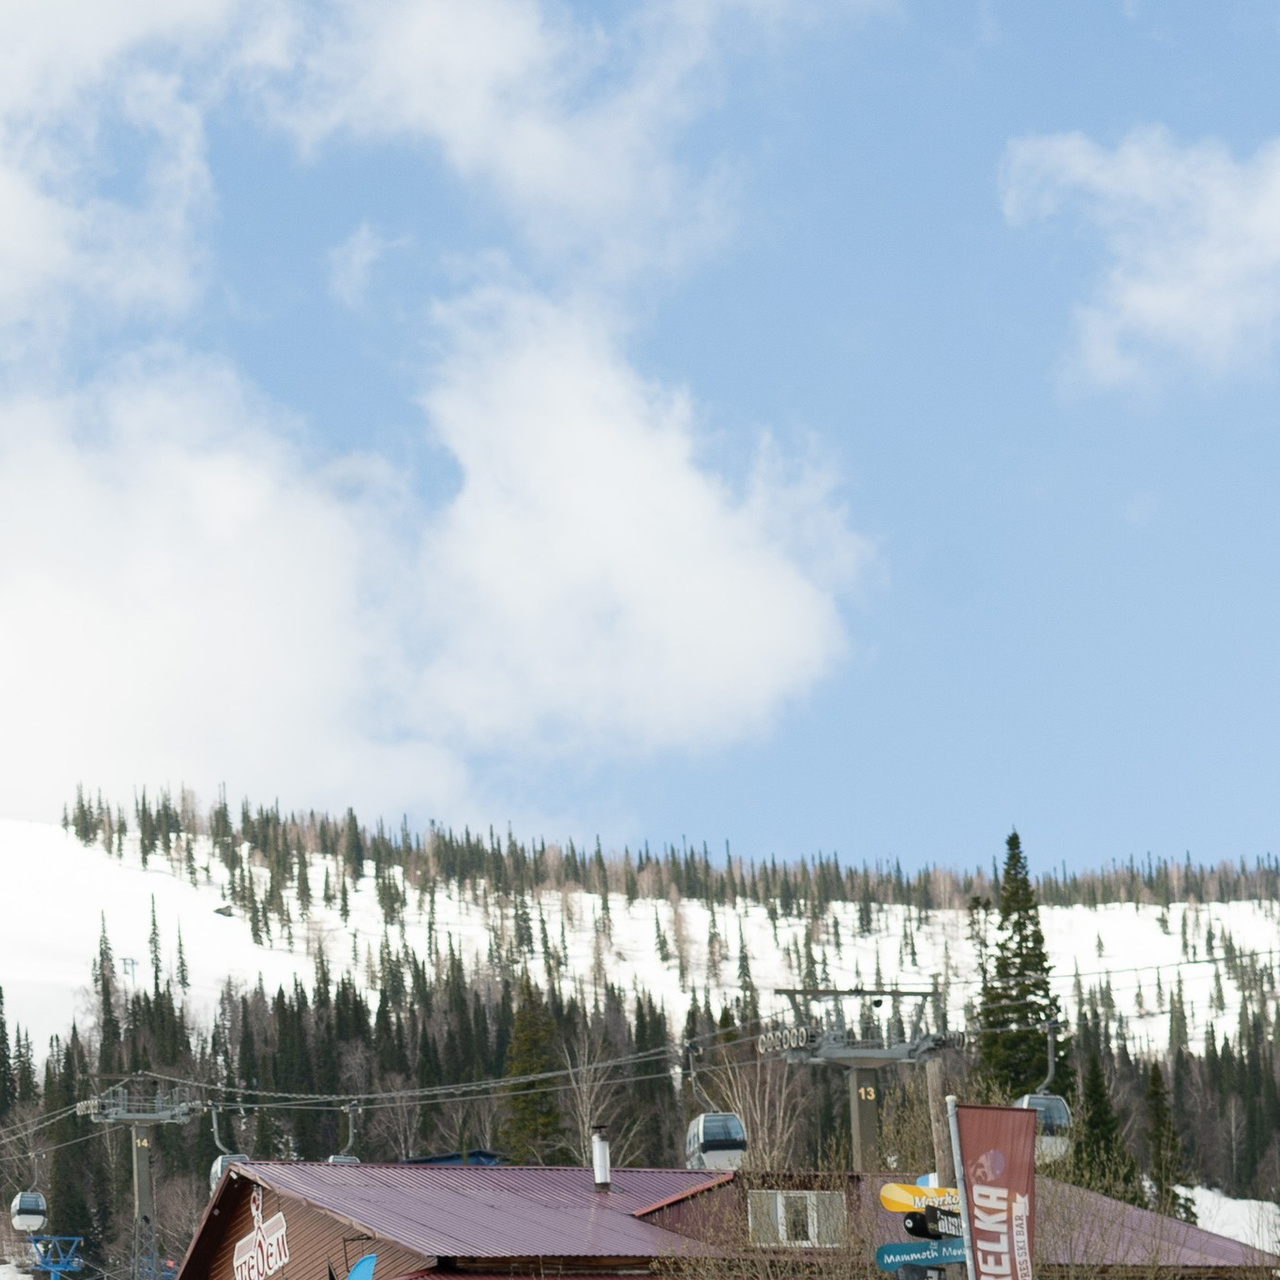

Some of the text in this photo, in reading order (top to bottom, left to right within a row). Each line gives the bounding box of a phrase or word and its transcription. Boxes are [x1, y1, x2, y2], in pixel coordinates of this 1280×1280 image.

[858, 1086, 876, 1101] 13
[1014, 1214, 1025, 1237] BAR
[1016, 1239, 1027, 1258] SKI
[884, 1251, 939, 1264] Mammoth
